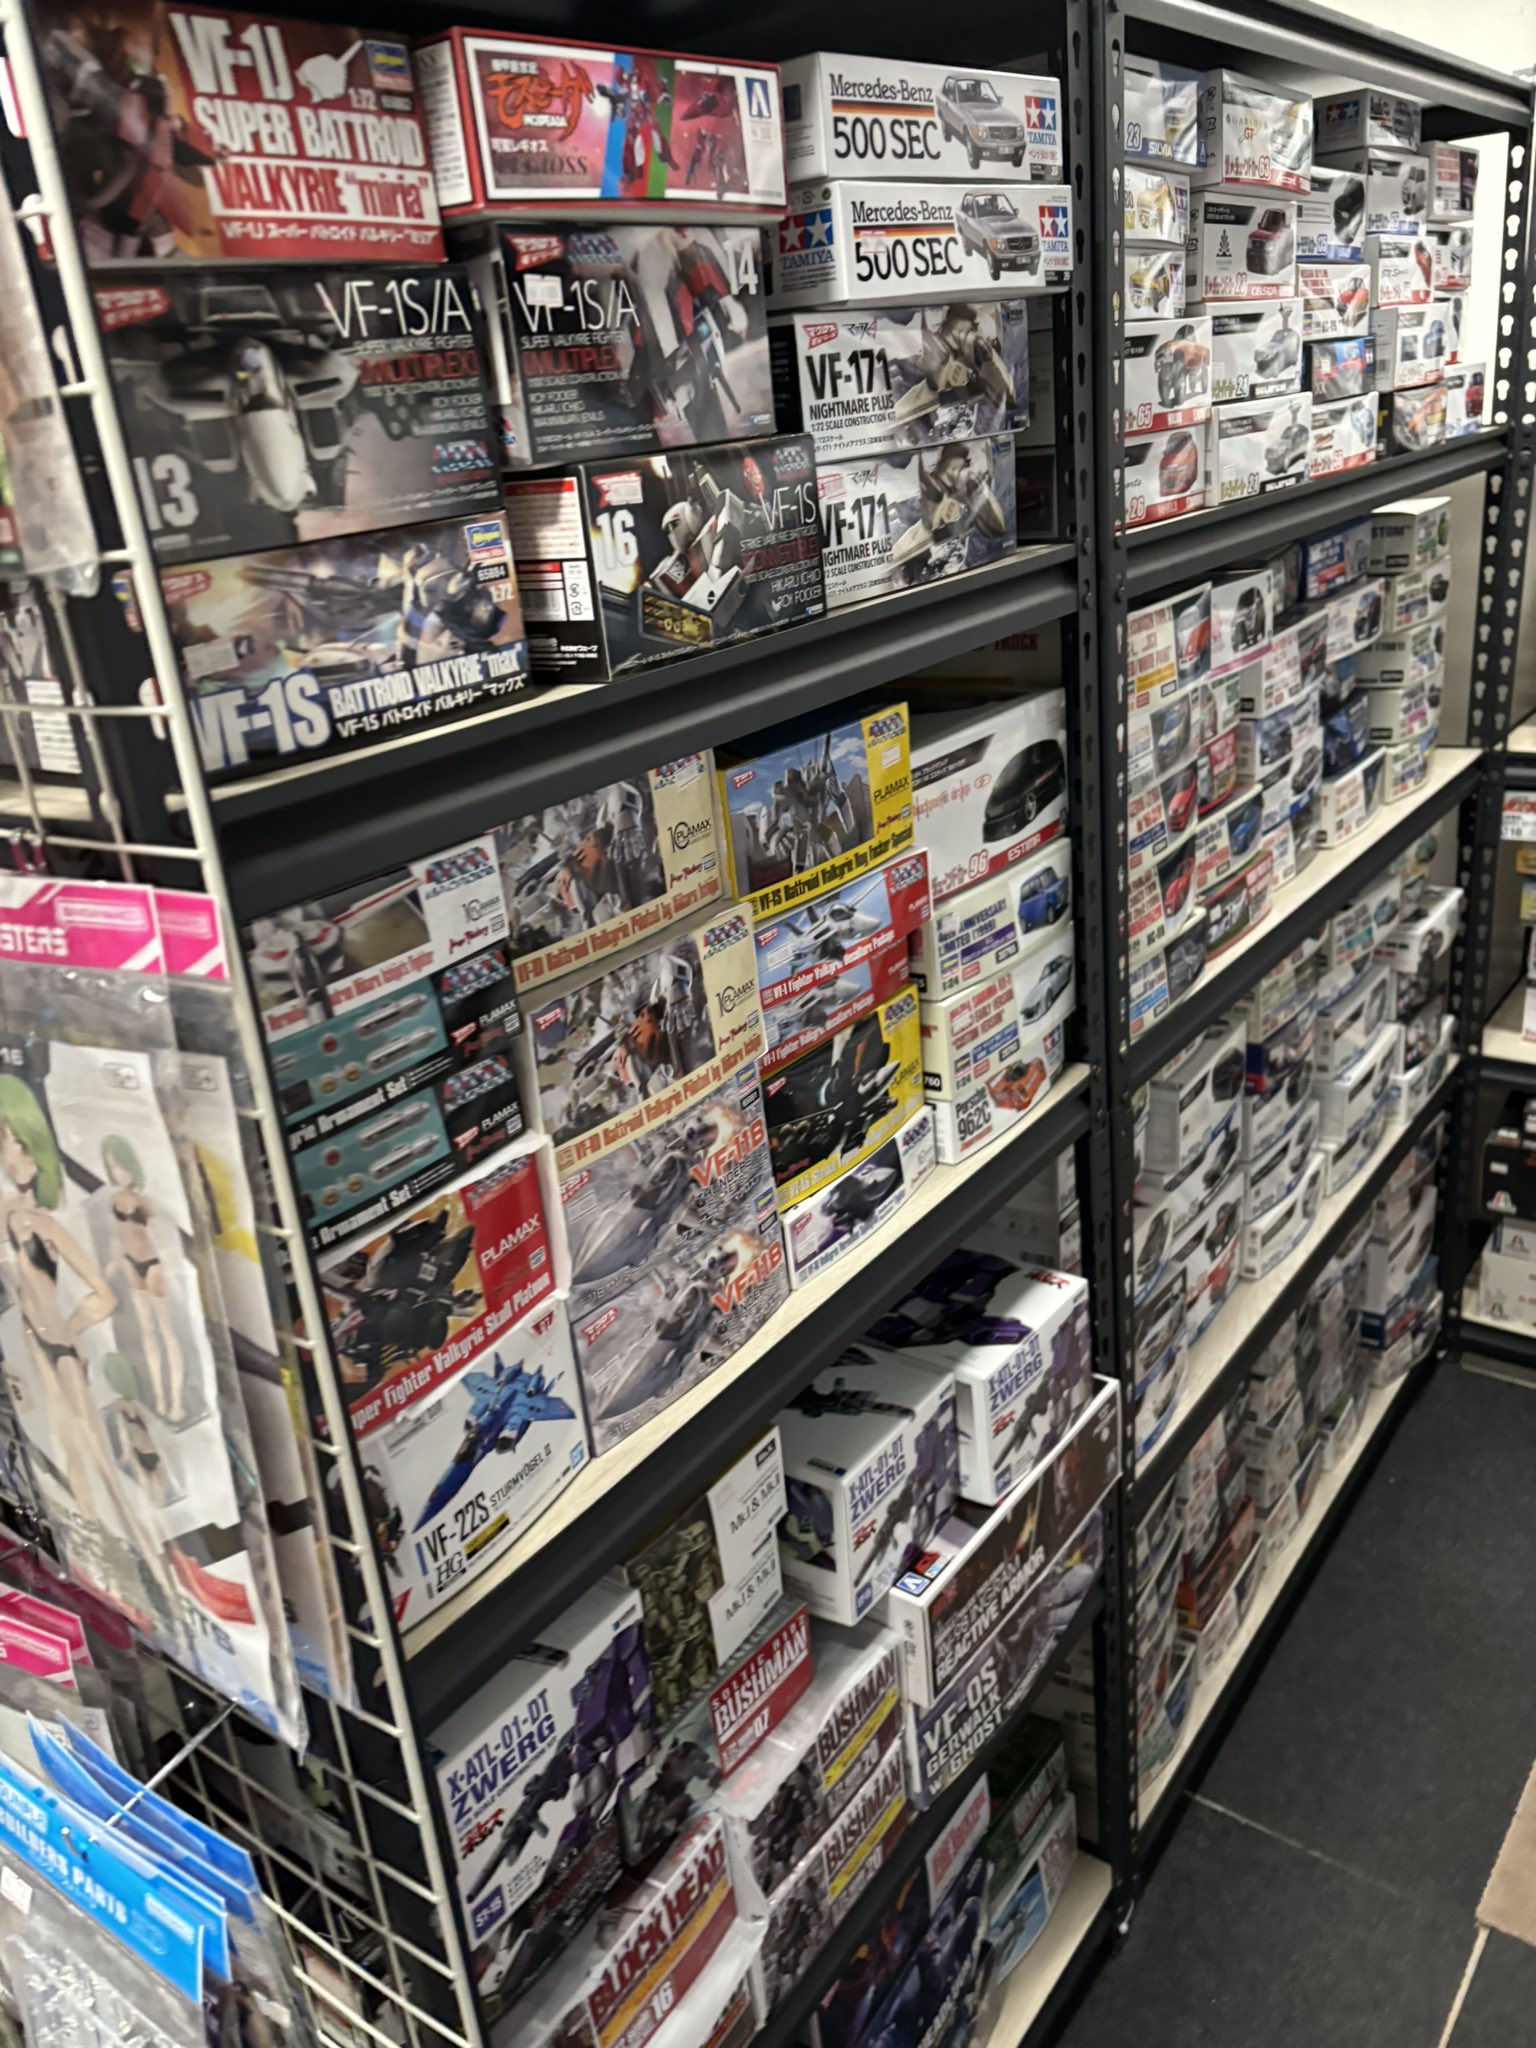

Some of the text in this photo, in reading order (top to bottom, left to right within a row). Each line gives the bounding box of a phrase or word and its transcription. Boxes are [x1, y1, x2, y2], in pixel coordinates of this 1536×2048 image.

[169, 12, 295, 101] VF-1J
[829, 73, 934, 102] Mercedes-Benz
[194, 97, 297, 155] SUPER
[296, 106, 425, 167] BATTROID
[833, 116, 942, 160] 500 SEC
[1027, 131, 1057, 146] TAMIYA
[1126, 122, 1141, 149] 23
[212, 161, 347, 214] VALKYRIE
[1258, 154, 1271, 179] 63
[851, 200, 954, 224] Mercedes-Benz
[723, 239, 759, 296] 14
[781, 249, 835, 270] TAMIYA
[913, 236, 964, 277] SEC
[1042, 240, 1069, 253] TAMIYA
[315, 278, 472, 338] VF-1S/A
[806, 348, 893, 400] VF-171
[1236, 375, 1249, 397] 21
[809, 394, 895, 420] NIGHTMARE PLUS
[825, 420, 844, 431] SCALE
[1137, 403, 1152, 428] 65
[758, 482, 816, 531] VF-1S
[820, 493, 891, 548] VF-171
[1129, 496, 1145, 519] 26
[596, 510, 638, 571] 16
[823, 537, 892, 568] IGHTMARE PLUS
[330, 677, 412, 718] BATTROID
[413, 653, 481, 702] VALKYRIE
[190, 672, 332, 773] VF-1S
[336, 715, 380, 739] VF-1S
[382, 702, 432, 730] バトロイド
[434, 691, 482, 714] バルキリー
[873, 776, 910, 803] PLAMAX
[968, 848, 990, 879] 96
[1008, 833, 1041, 862] ESTIMA
[479, 998, 517, 1026] PLAMAX
[386, 1077, 411, 1100] Set
[482, 1100, 519, 1131] PLAMAX
[957, 1101, 992, 1142] 962C
[688, 1117, 766, 1189] VF-11B
[390, 1184, 413, 1207] Set
[480, 1213, 541, 1269] PLAMAX
[712, 1240, 784, 1315] VF-11B
[350, 1398, 382, 1430] uper
[383, 1362, 433, 1416] Fighter
[432, 1324, 484, 1377] Valkyrie
[484, 1300, 514, 1334] Skull
[513, 1273, 551, 1318] Platoon
[990, 1353, 1043, 1414] ZWERG
[850, 1454, 907, 1523] ZWERG
[424, 1491, 490, 1563] VF-22S
[436, 1551, 464, 1588] HG
[935, 1543, 1046, 1689] REACTIVE ARMOR
[714, 1622, 809, 1736] BUSHMAN
[752, 1704, 770, 1738] 07
[817, 1648, 898, 1761] BUSHMAN
[925, 1683, 1001, 1779] GERWALK
[949, 1703, 1002, 1776] GHOST
[452, 1713, 556, 1825] ZWERG
[823, 1753, 902, 1872] BUSHMAN
[71, 1864, 128, 1925] PARTS
[650, 1980, 674, 2022] 16
